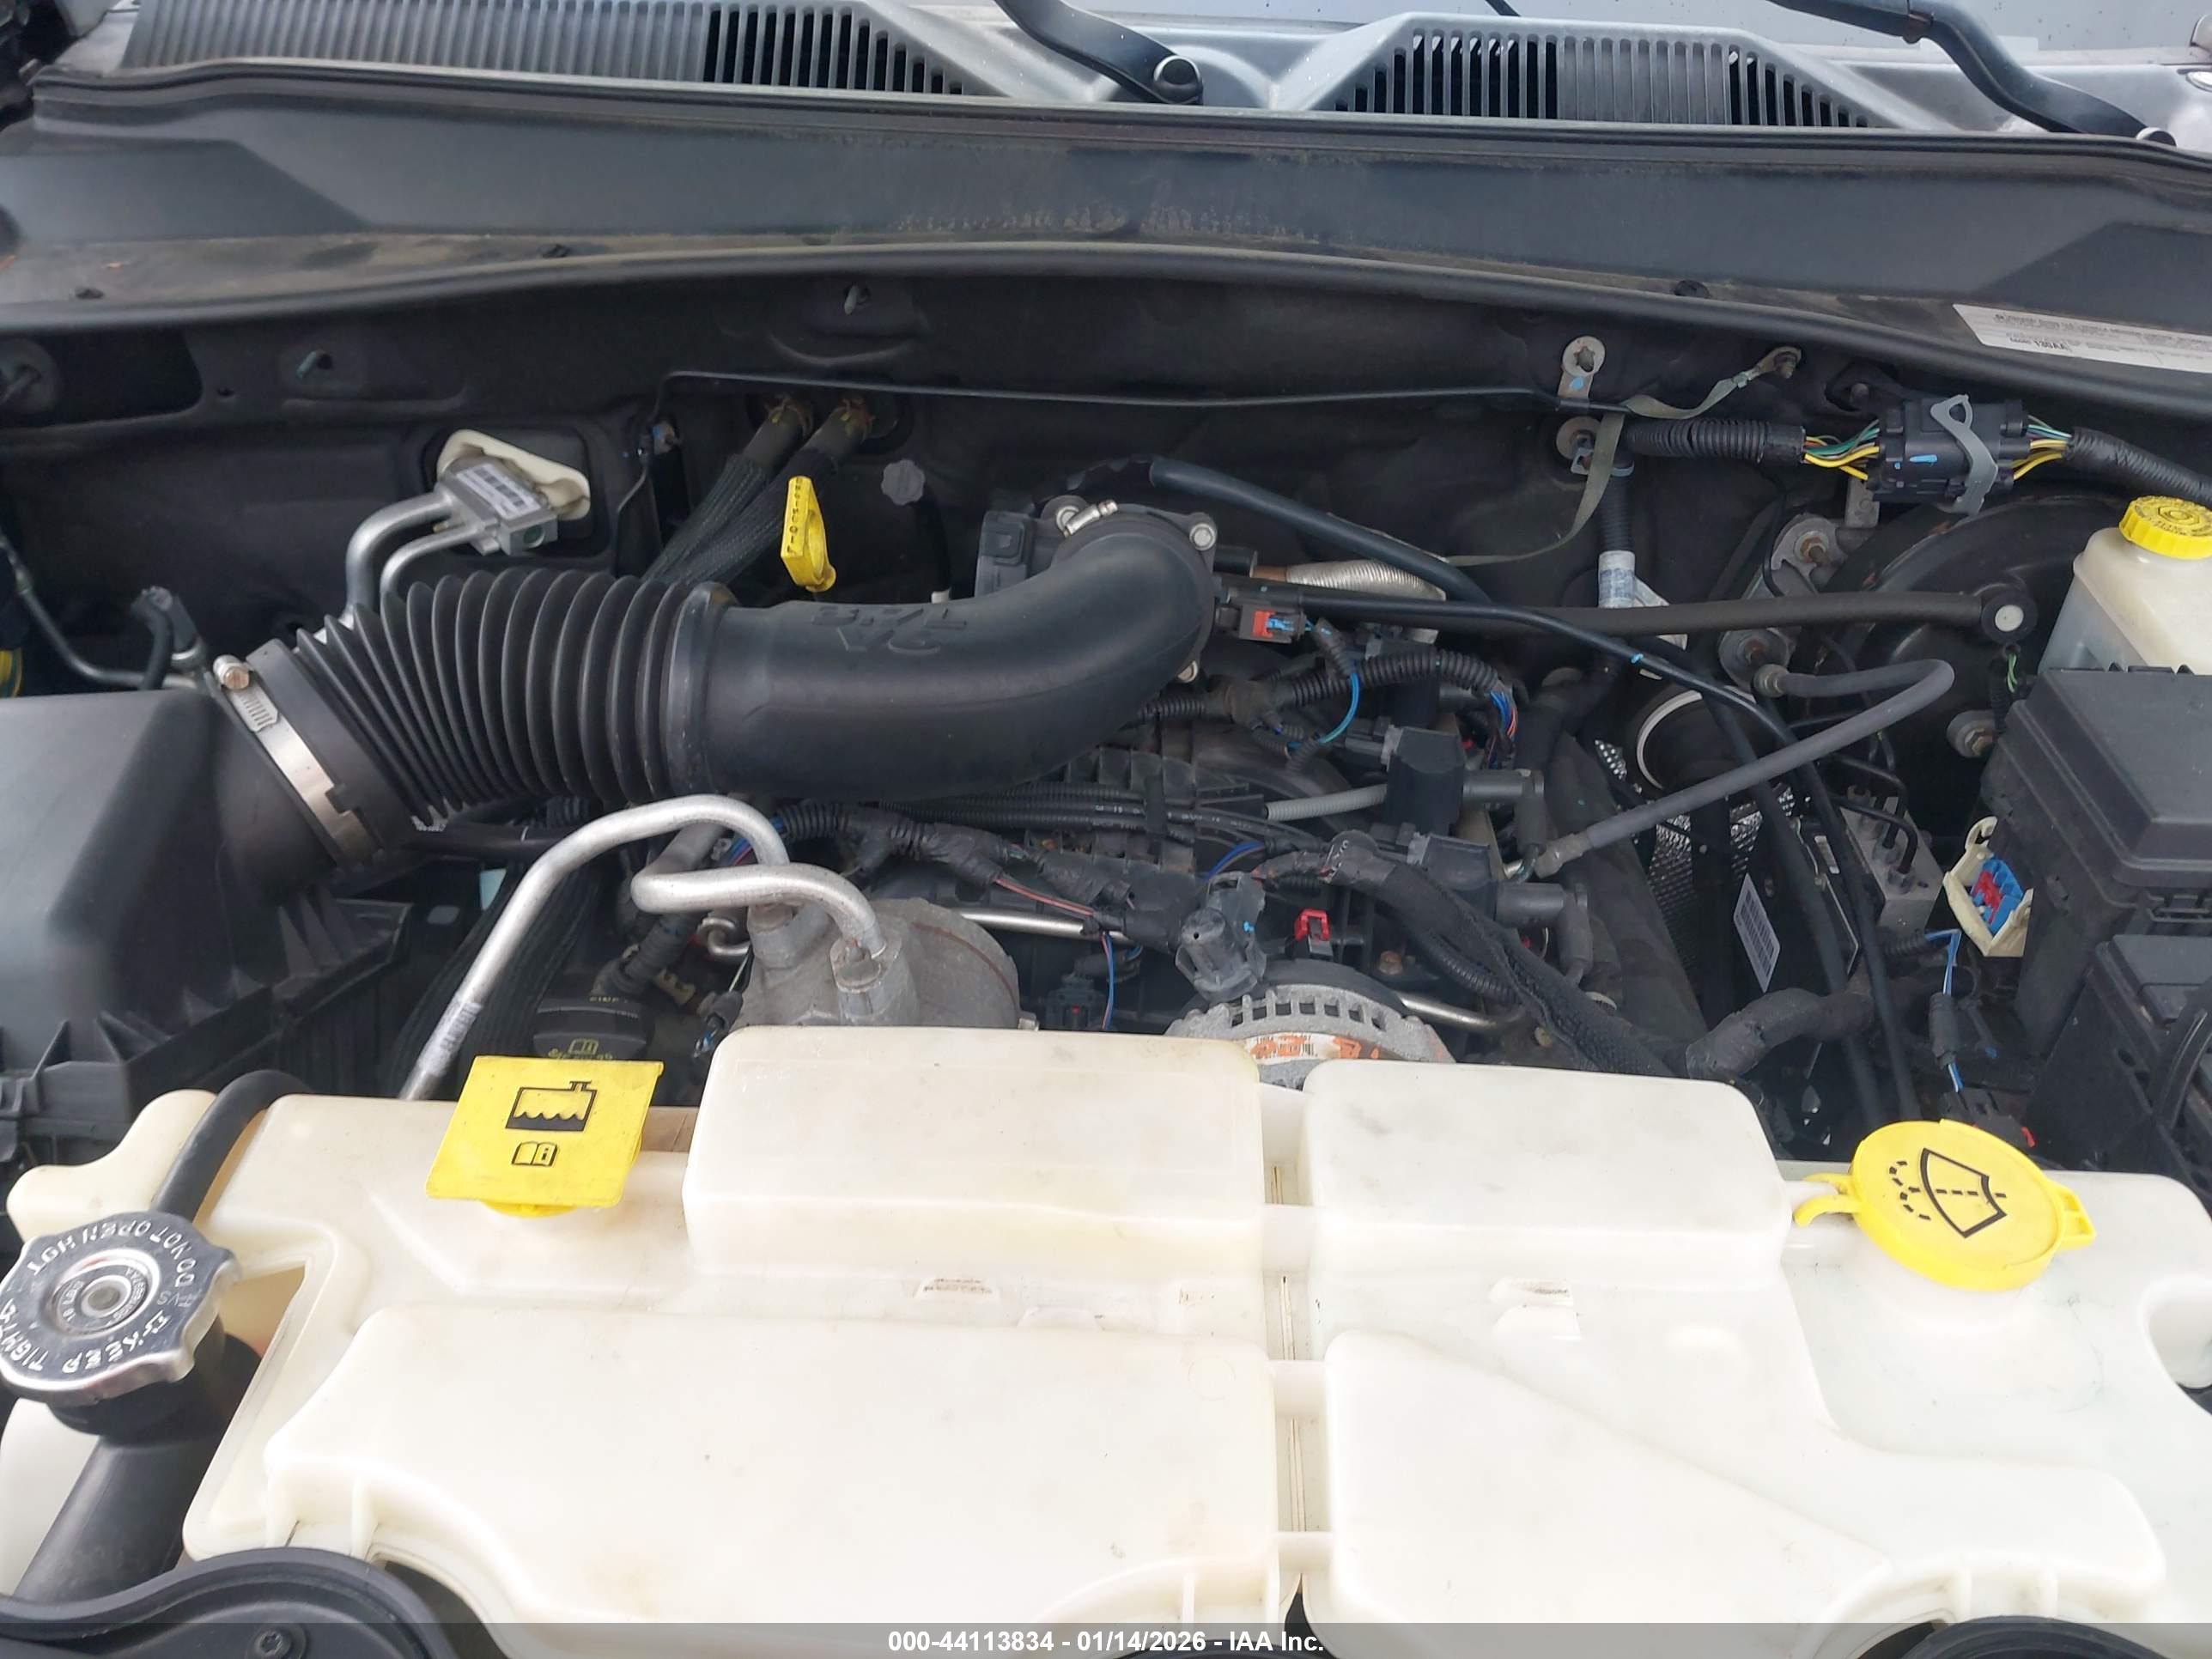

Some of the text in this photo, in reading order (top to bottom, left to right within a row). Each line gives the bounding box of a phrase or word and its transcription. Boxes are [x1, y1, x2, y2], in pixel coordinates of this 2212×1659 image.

[27, 1220, 196, 1287] DO NOT OPEN HOT
[62, 1332, 143, 1373] KEEP
